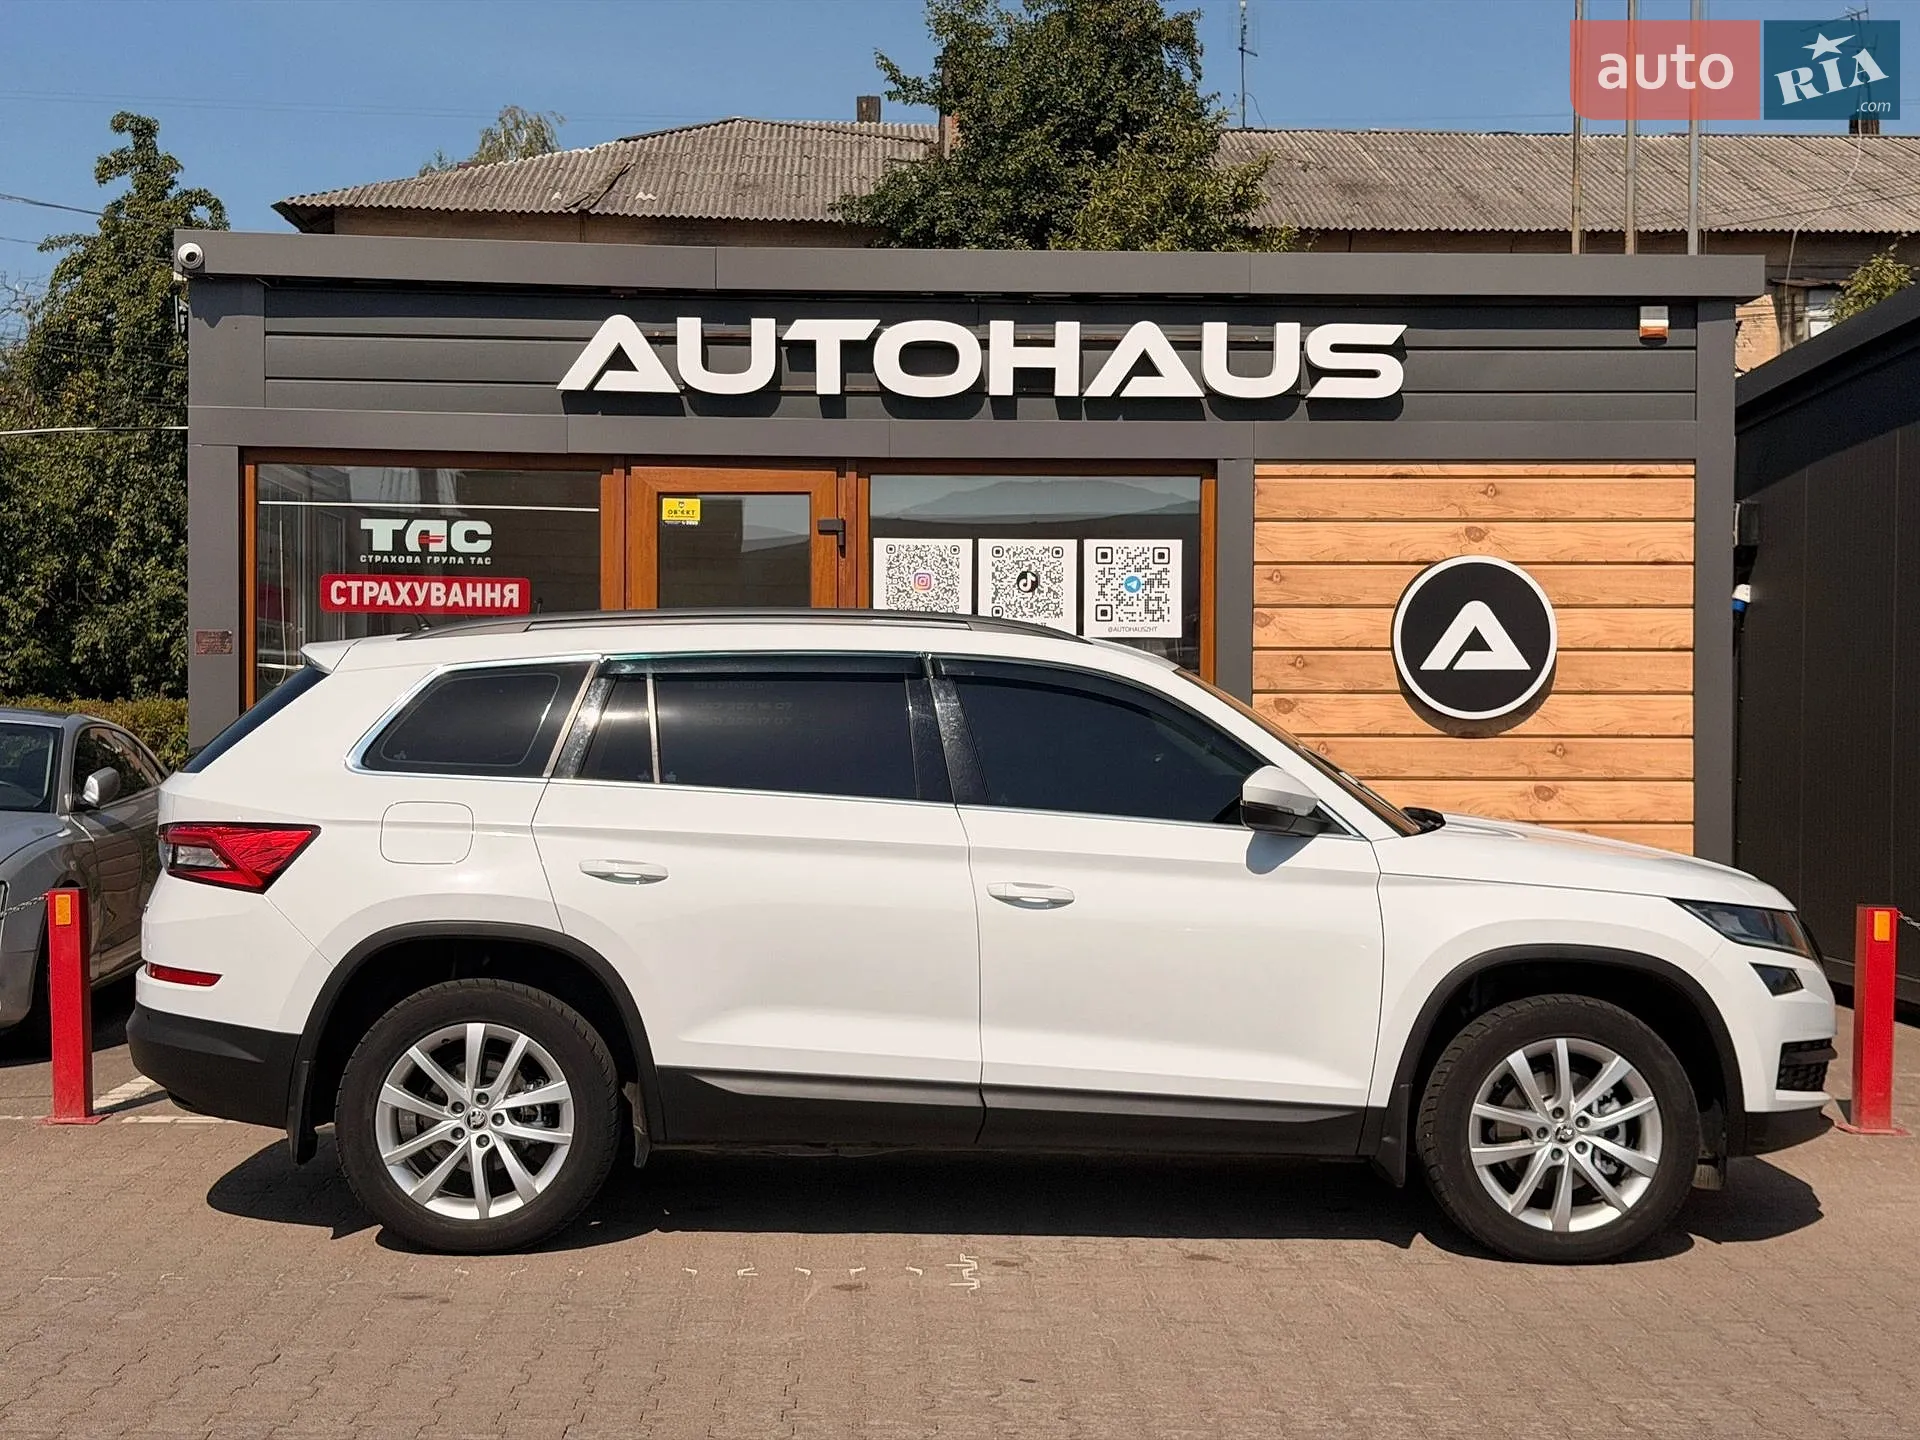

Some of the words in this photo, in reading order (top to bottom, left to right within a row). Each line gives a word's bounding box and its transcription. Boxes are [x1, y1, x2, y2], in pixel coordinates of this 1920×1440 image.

[556, 314, 1408, 399] AUTOHAUS
[360, 554, 421, 563] СТРАХОВА
[427, 555, 465, 564] ГРУПА
[470, 556, 492, 565] ТАС
[330, 580, 520, 608] СТРАХУВАННЯ
